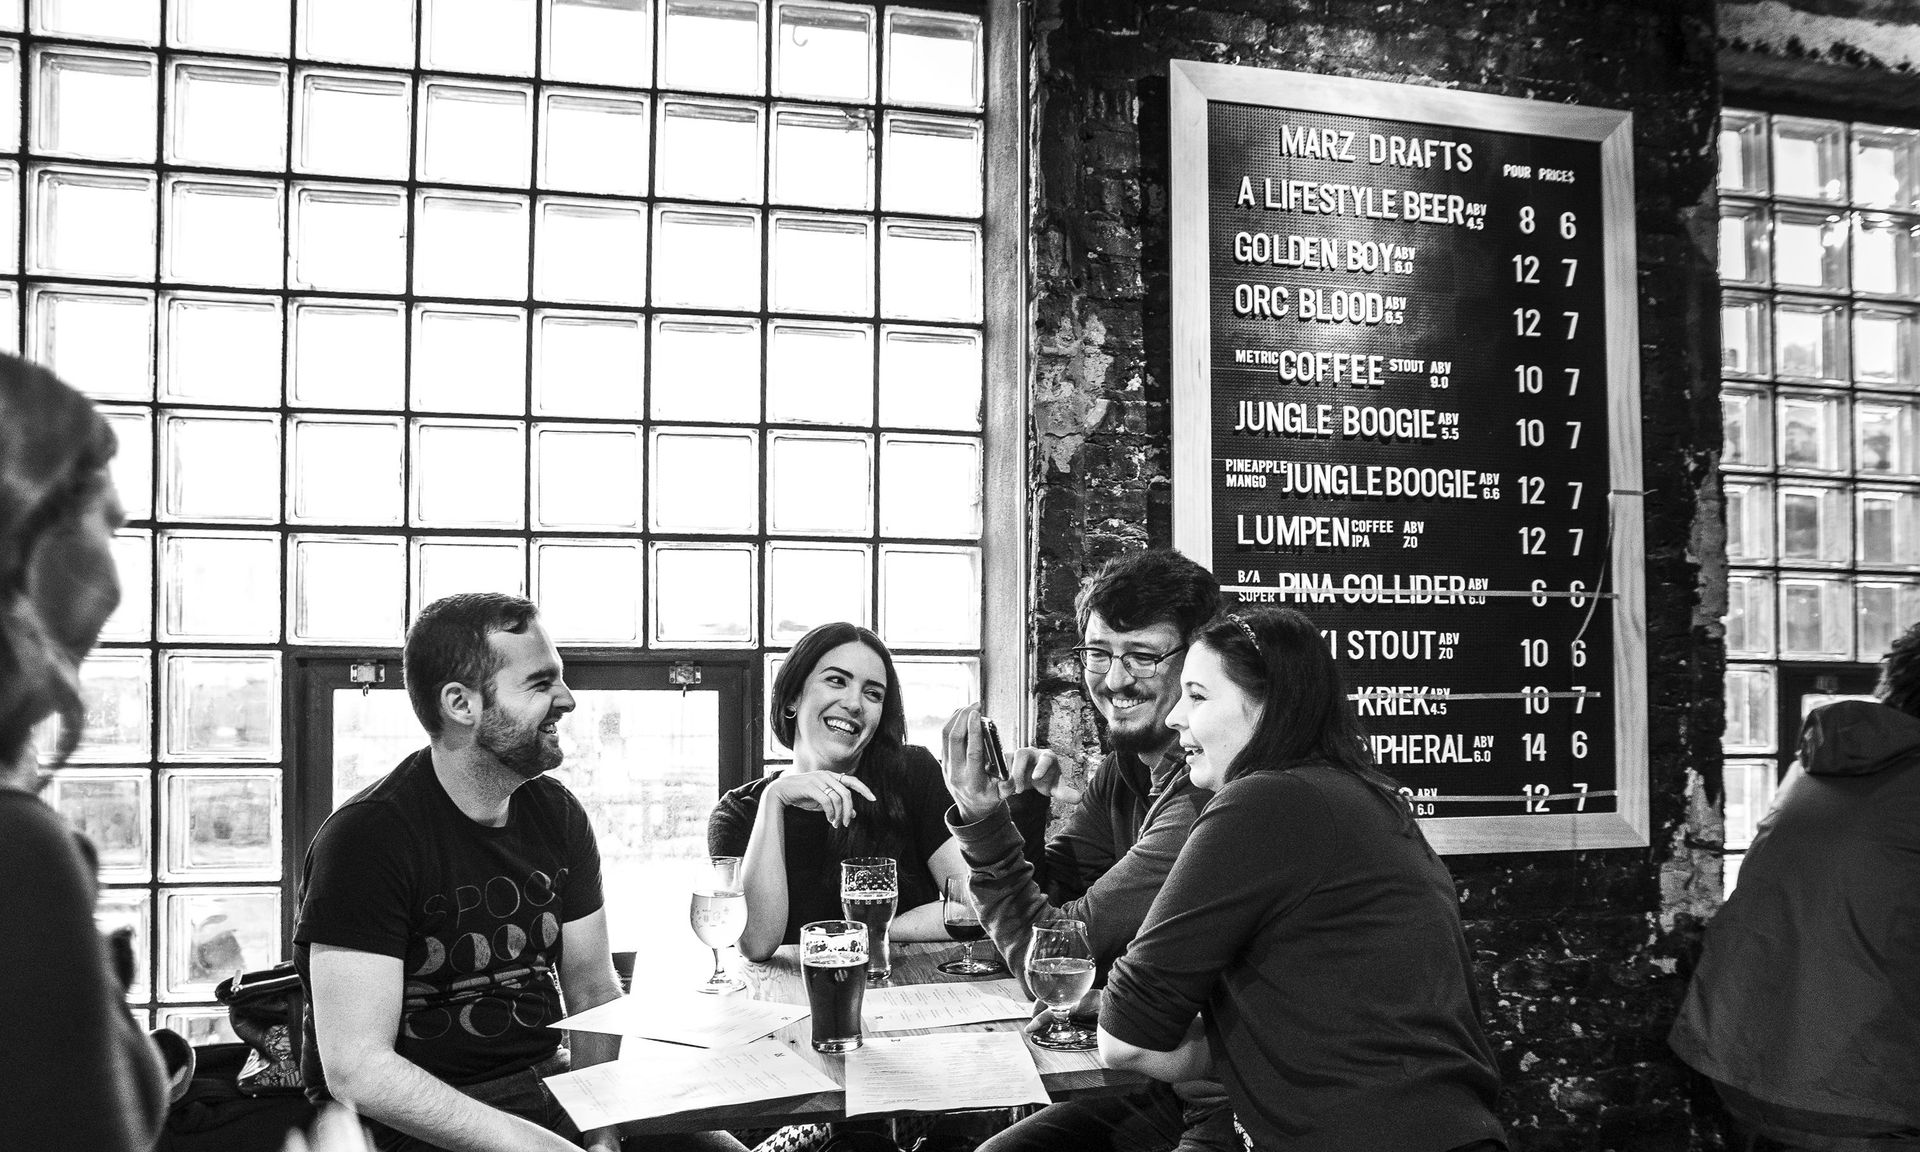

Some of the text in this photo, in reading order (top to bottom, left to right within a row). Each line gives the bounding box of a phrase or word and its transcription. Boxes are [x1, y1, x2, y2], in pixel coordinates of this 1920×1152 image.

[1280, 124, 1473, 172] MARZ DRAFTS
[1503, 163, 1575, 183] POUR PRICES
[1237, 175, 1464, 225] A LIFESTYLE BEER
[1465, 202, 1487, 217] ABV
[1466, 216, 1484, 231] 4.5
[1519, 205, 1577, 240] 8 6
[1235, 231, 1394, 273] GOLDEN BOY
[1393, 246, 1416, 260] ABV
[1512, 254, 1578, 287] 12 7
[1235, 283, 1383, 323] ORC BLOOD
[1384, 295, 1407, 310] ABV
[1513, 307, 1579, 340] 12 7
[1235, 349, 1385, 385] METRIC COFFEE
[1388, 358, 1452, 375] STOUT ABV
[1514, 364, 1580, 396] 10 7
[1235, 400, 1437, 439] JUNGLE BOOGIE
[1437, 412, 1460, 426] ABV
[1441, 427, 1460, 441] 5.5
[1516, 418, 1581, 449] 10 7
[1225, 458, 1288, 474] PINEAPPLE
[1225, 473, 1267, 489] MANGO
[1478, 472, 1500, 486] ABV
[1482, 487, 1500, 500] 6.6
[1517, 475, 1583, 510] 12 7
[1237, 514, 1350, 547] LUMPEN
[1350, 519, 1425, 534] COFFEE ABV
[1351, 534, 1371, 548] IPA
[1518, 526, 1584, 556] 12 7
[1237, 569, 1261, 584] B/A
[1278, 572, 1466, 605] PINA COLLIDER
[1468, 577, 1488, 590] ABV
[1238, 590, 1275, 603] SUPER
[1531, 579, 1586, 608] 6 6
[1347, 629, 1437, 660] STOUT
[1438, 632, 1460, 646] ABV
[1520, 638, 1587, 668] 10 6
[1357, 686, 1431, 716] KRIEK
[1430, 702, 1447, 716] 4.5
[1521, 685, 1587, 715] 10 7
[1473, 735, 1494, 748] ABV
[1521, 730, 1588, 762] 14 6
[1473, 750, 1491, 763] 6.0
[1417, 803, 1435, 816] 6.0
[1522, 782, 1588, 813] 12 7
